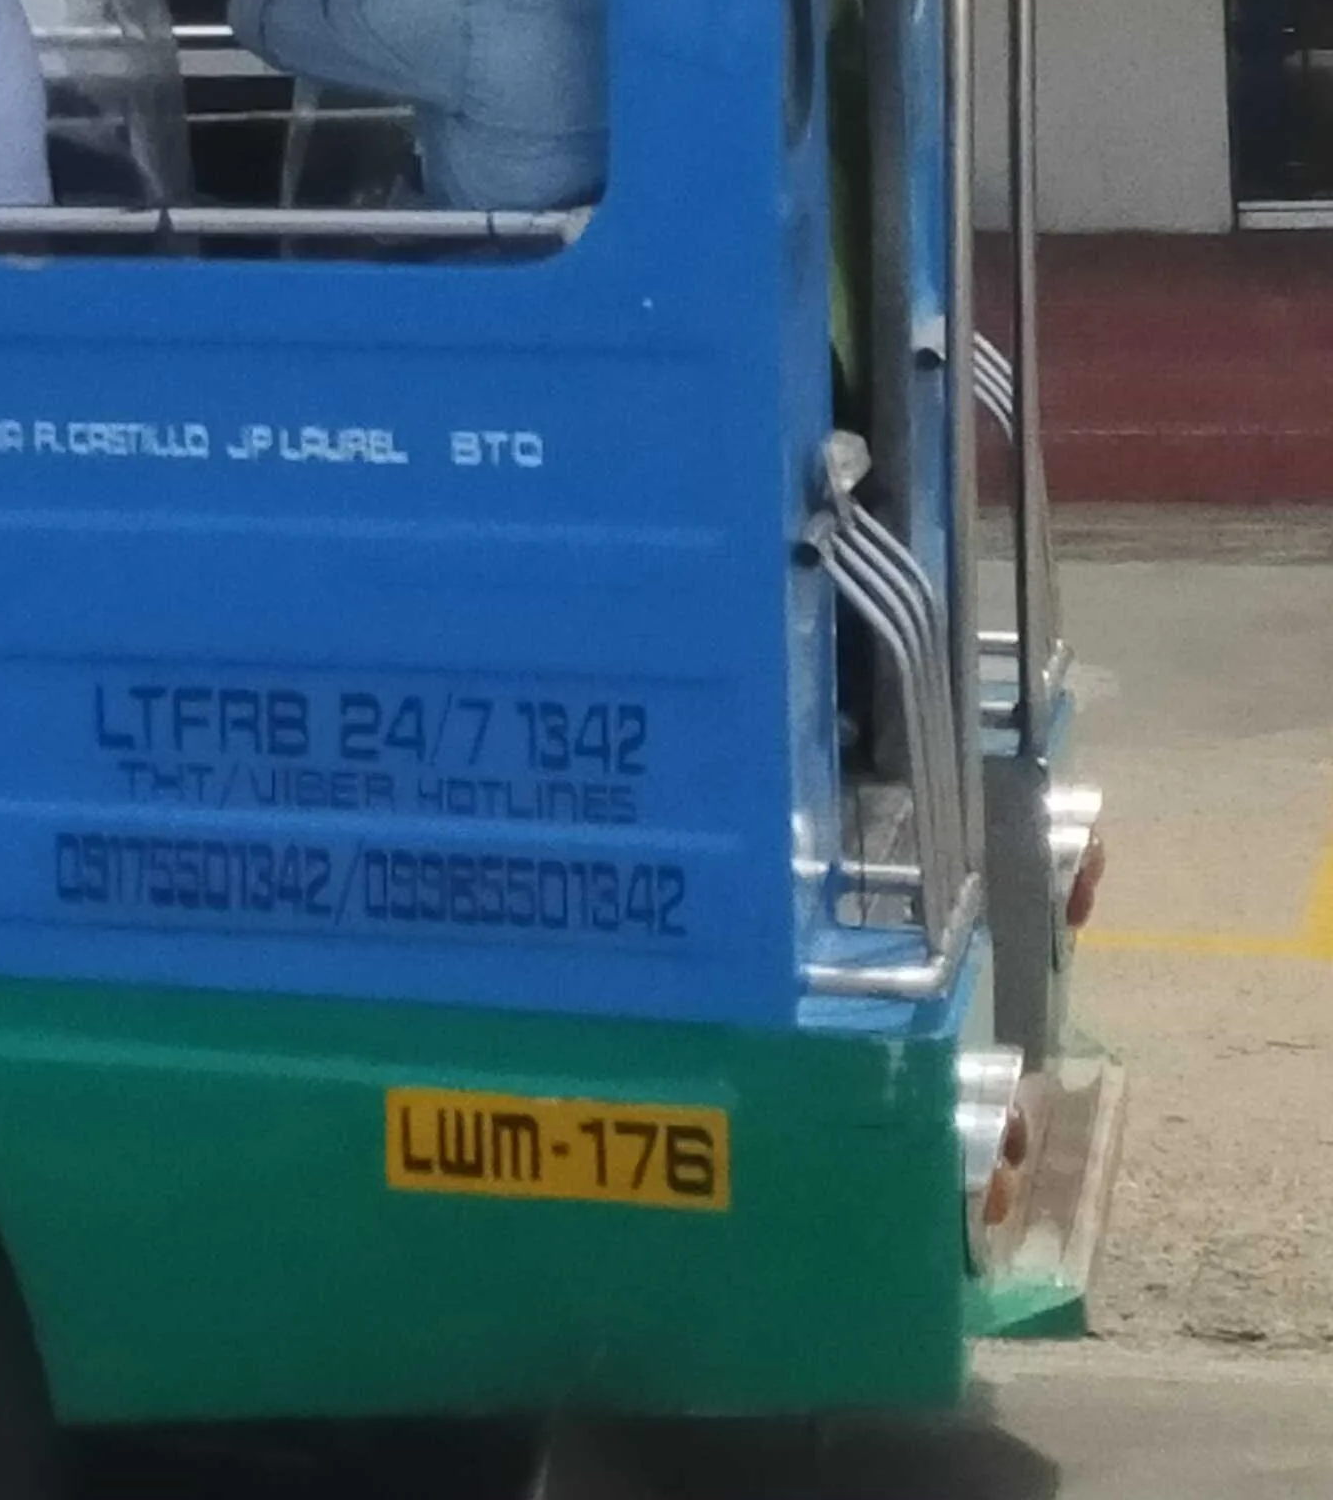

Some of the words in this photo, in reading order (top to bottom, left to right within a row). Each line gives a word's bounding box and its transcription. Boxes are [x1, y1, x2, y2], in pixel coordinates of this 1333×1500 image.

[94, 683, 310, 758] LTFRB
[339, 690, 494, 767] 24/7
[516, 701, 649, 777] 1342
